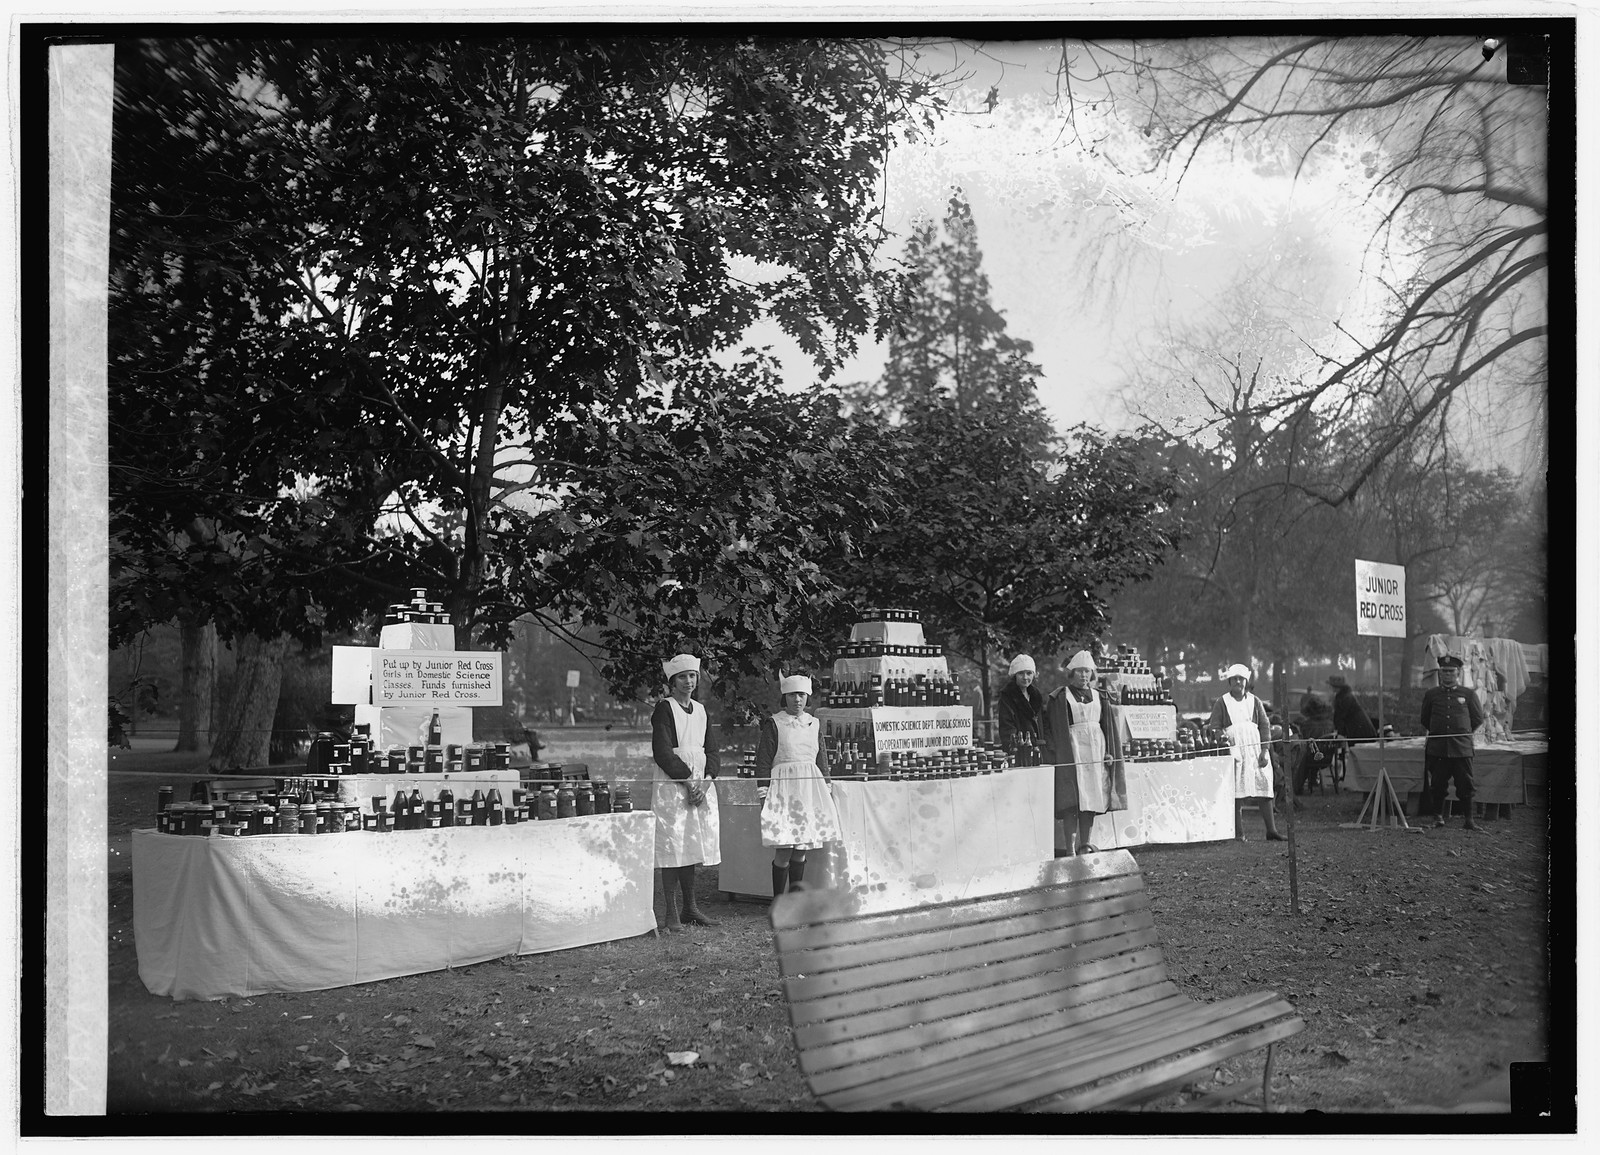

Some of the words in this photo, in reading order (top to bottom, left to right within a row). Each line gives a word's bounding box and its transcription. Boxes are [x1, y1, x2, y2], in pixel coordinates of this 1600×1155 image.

[1366, 576, 1398, 595] JUNIOR
[1360, 602, 1377, 618] RED
[1379, 604, 1403, 621] CROSS
[383, 659, 397, 669] Put
[399, 661, 409, 671] up
[412, 660, 422, 671] by
[426, 660, 453, 670] Junior
[458, 661, 472, 670] Red
[475, 661, 493, 670] Cross
[383, 669, 402, 678] Girls
[406, 670, 413, 678] in
[418, 670, 451, 679] Domestic
[456, 671, 490, 679] Science
[422, 680, 446, 689] Funds
[452, 680, 491, 689] furnished
[384, 691, 393, 699] by
[876, 720, 900, 732] DOMESTIC
[901, 720, 922, 731] SCIENCE
[936, 719, 952, 729] PUBLIC
[952, 718, 971, 728] SCHOOLS
[877, 738, 911, 750] CO-OPERATING
[911, 738, 924, 748] WITH
[924, 737, 941, 748] JUNIOR
[942, 736, 951, 747] RED
[952, 735, 968, 746] CROSS
